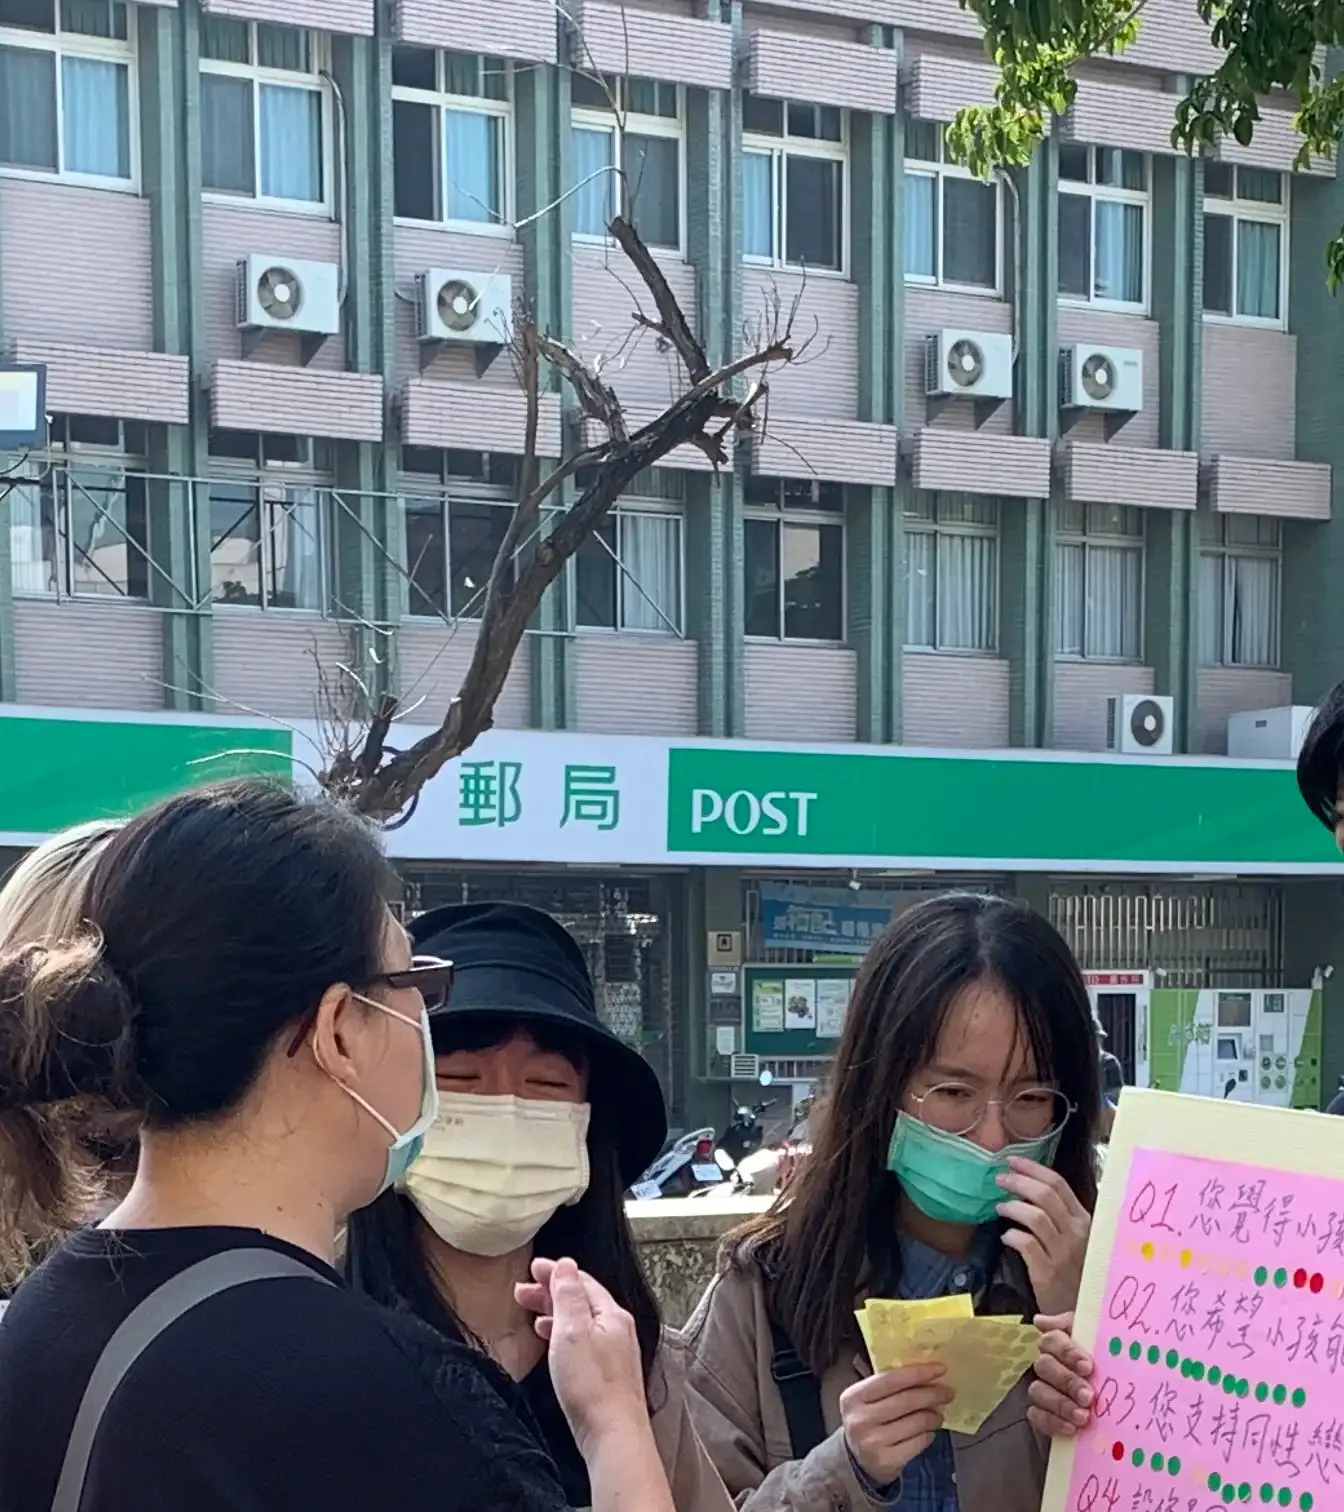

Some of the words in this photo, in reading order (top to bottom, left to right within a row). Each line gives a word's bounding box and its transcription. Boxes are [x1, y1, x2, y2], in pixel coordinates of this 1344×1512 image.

[458, 758, 621, 832] 郵局
[690, 788, 818, 837] POST
[1129, 1179, 1183, 1237] Q1.
[1109, 1275, 1160, 1336] Q2.
